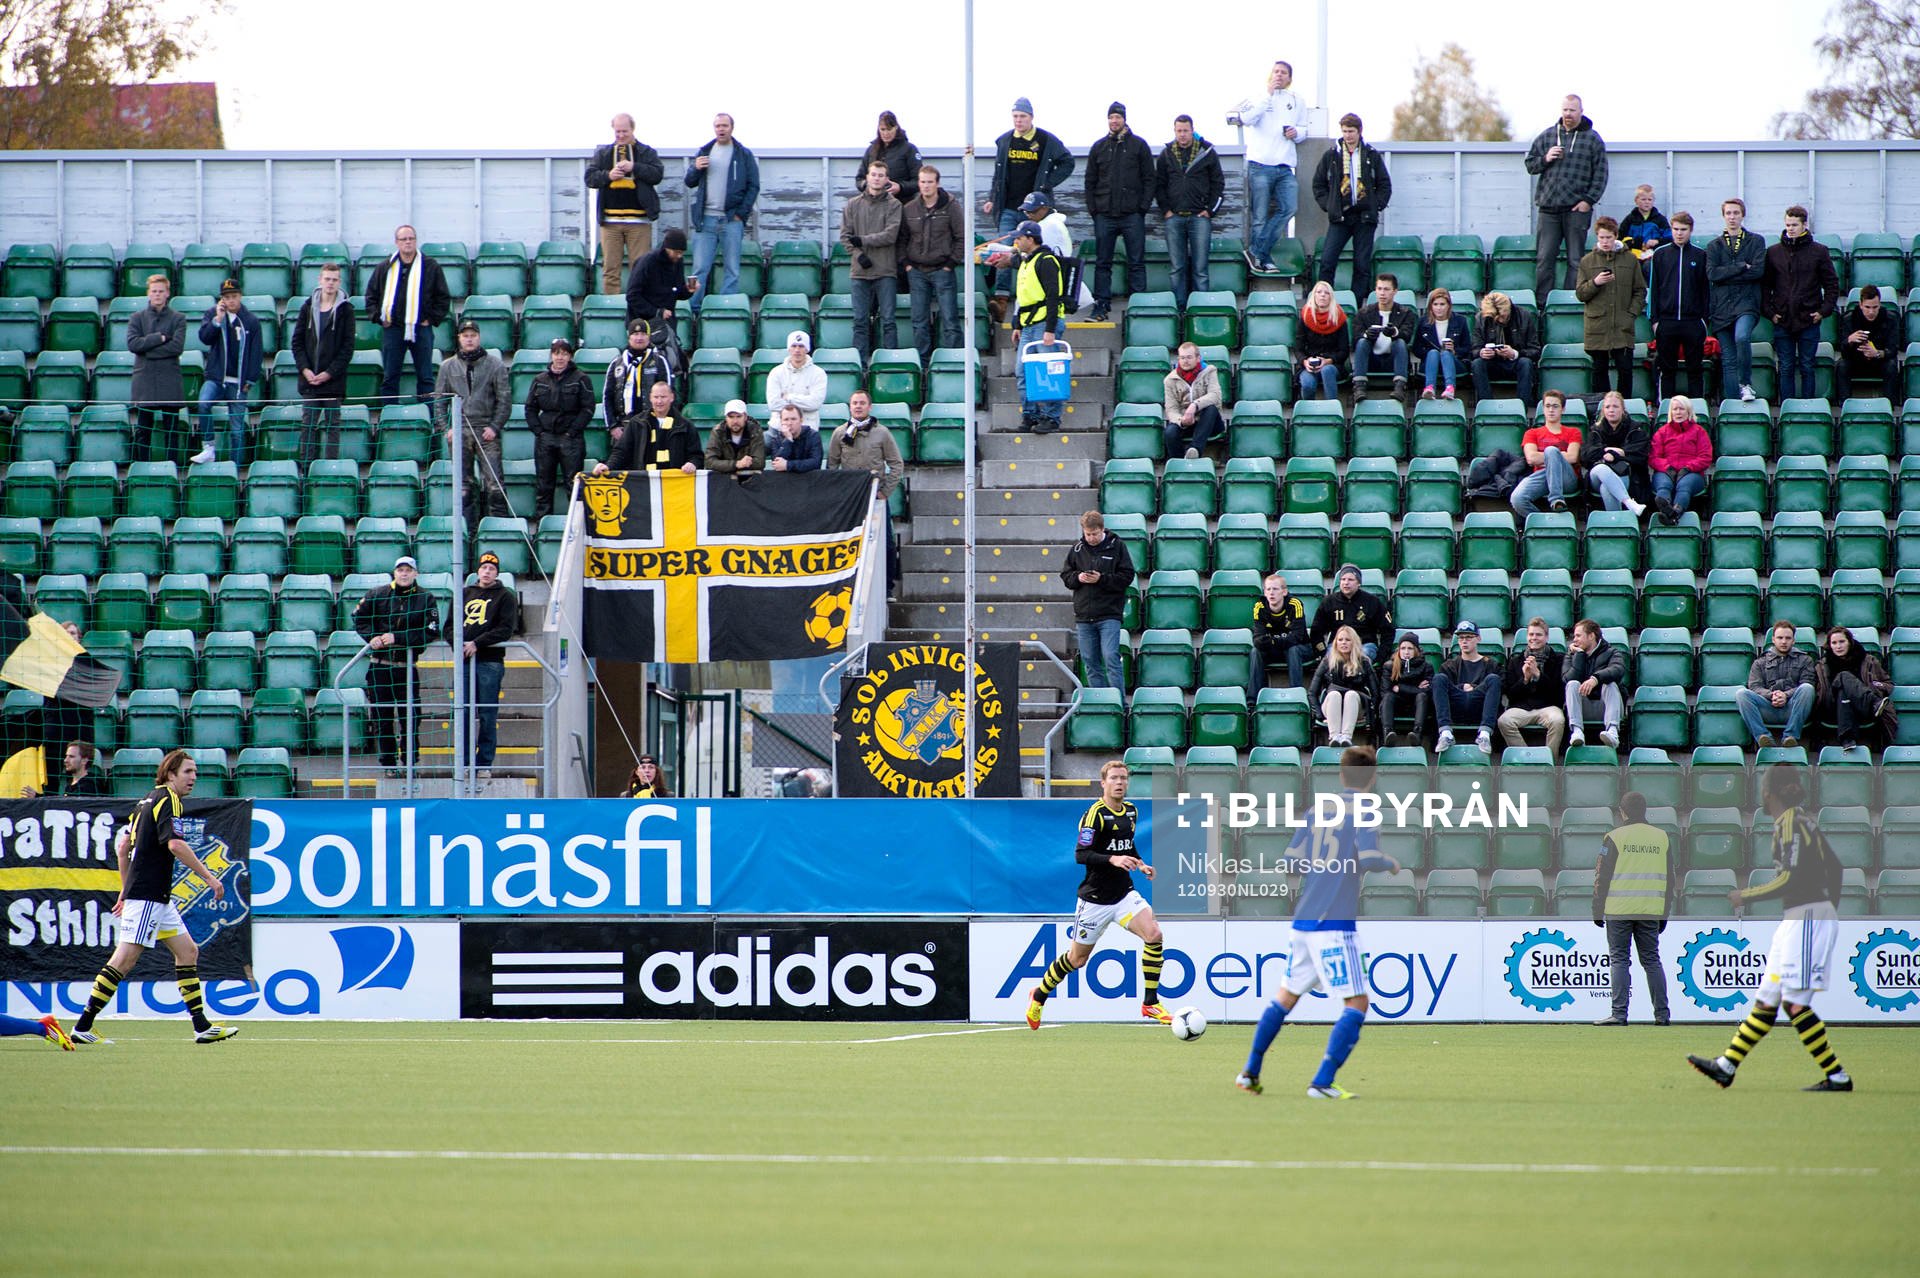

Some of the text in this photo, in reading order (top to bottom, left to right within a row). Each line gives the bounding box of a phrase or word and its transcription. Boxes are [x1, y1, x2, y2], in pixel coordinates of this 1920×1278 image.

[590, 549, 712, 578] SUPER
[852, 669, 889, 725] SOL
[861, 749, 907, 794] AIK
[250, 804, 711, 908] Bollnäsfil
[1531, 950, 1632, 967] Sundsva
[1532, 969, 1631, 986] Mekanis
